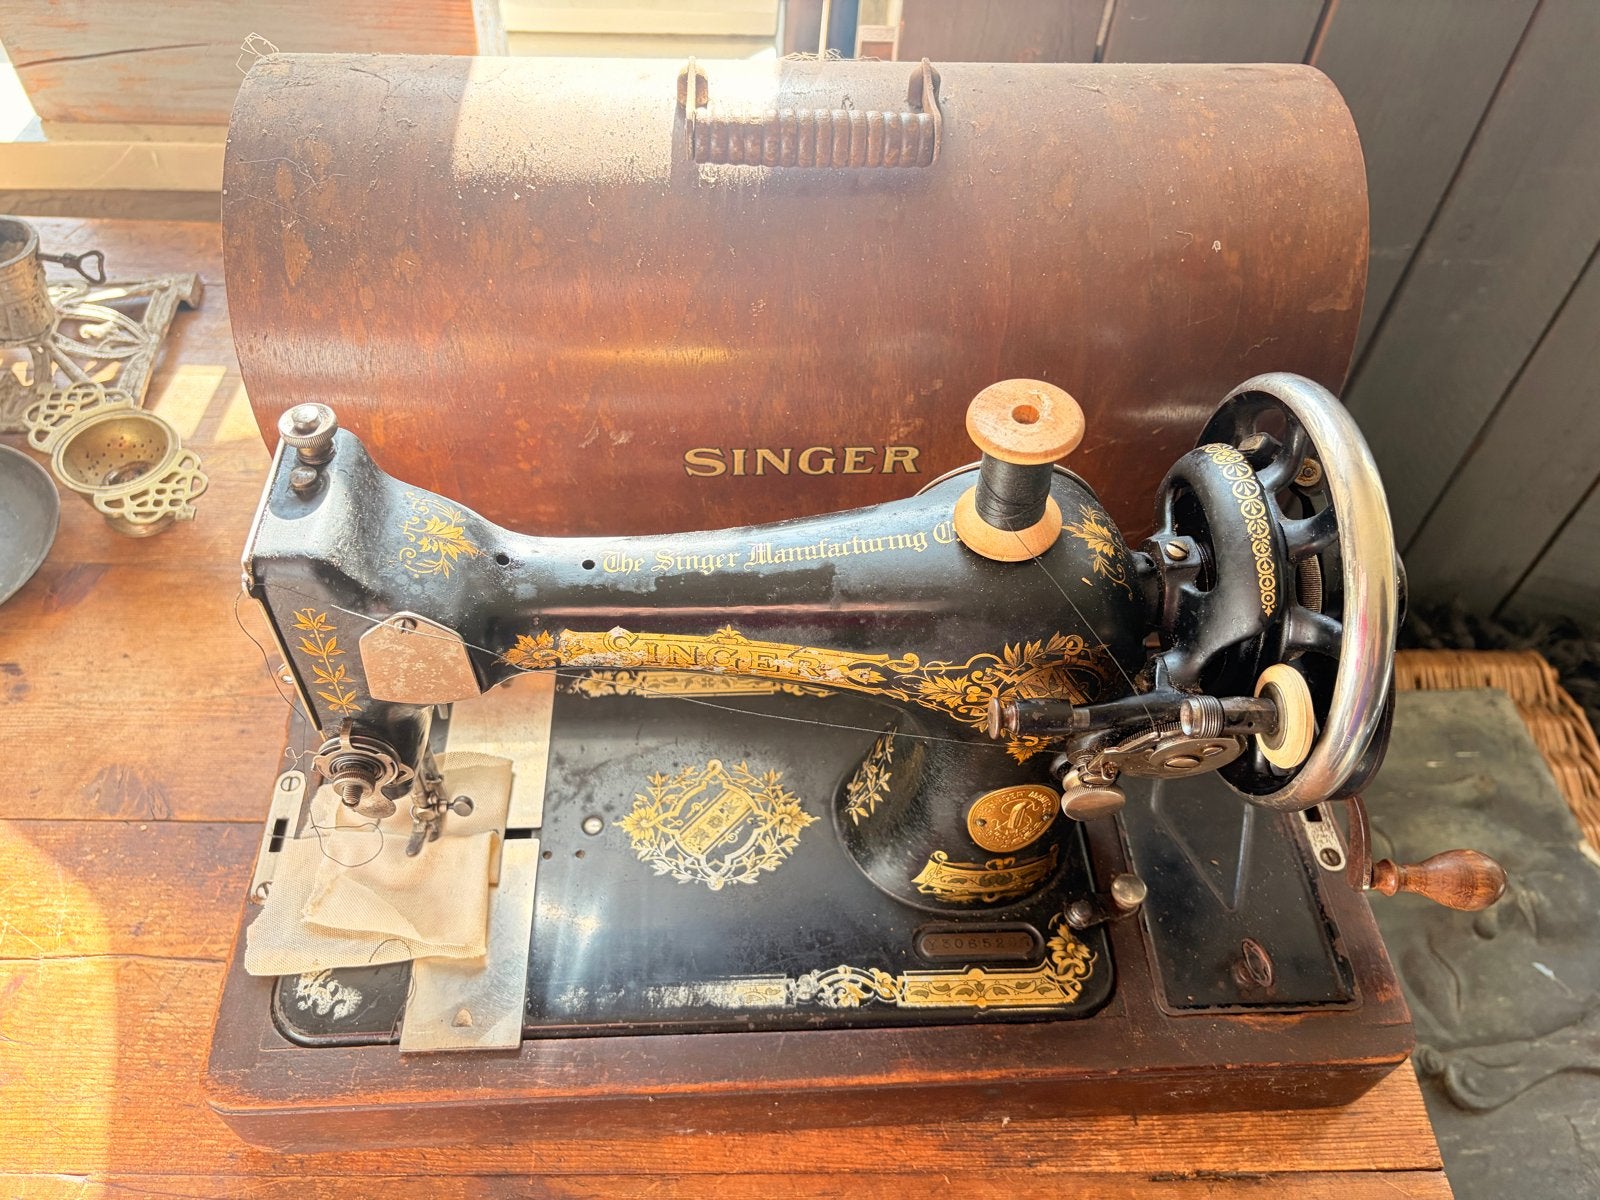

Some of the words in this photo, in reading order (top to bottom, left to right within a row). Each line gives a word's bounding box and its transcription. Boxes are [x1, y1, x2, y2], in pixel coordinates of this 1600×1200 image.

[683, 447, 922, 477] SINGER
[602, 550, 646, 575] The
[651, 550, 741, 575] Singer
[744, 532, 928, 571] Manufacturing
